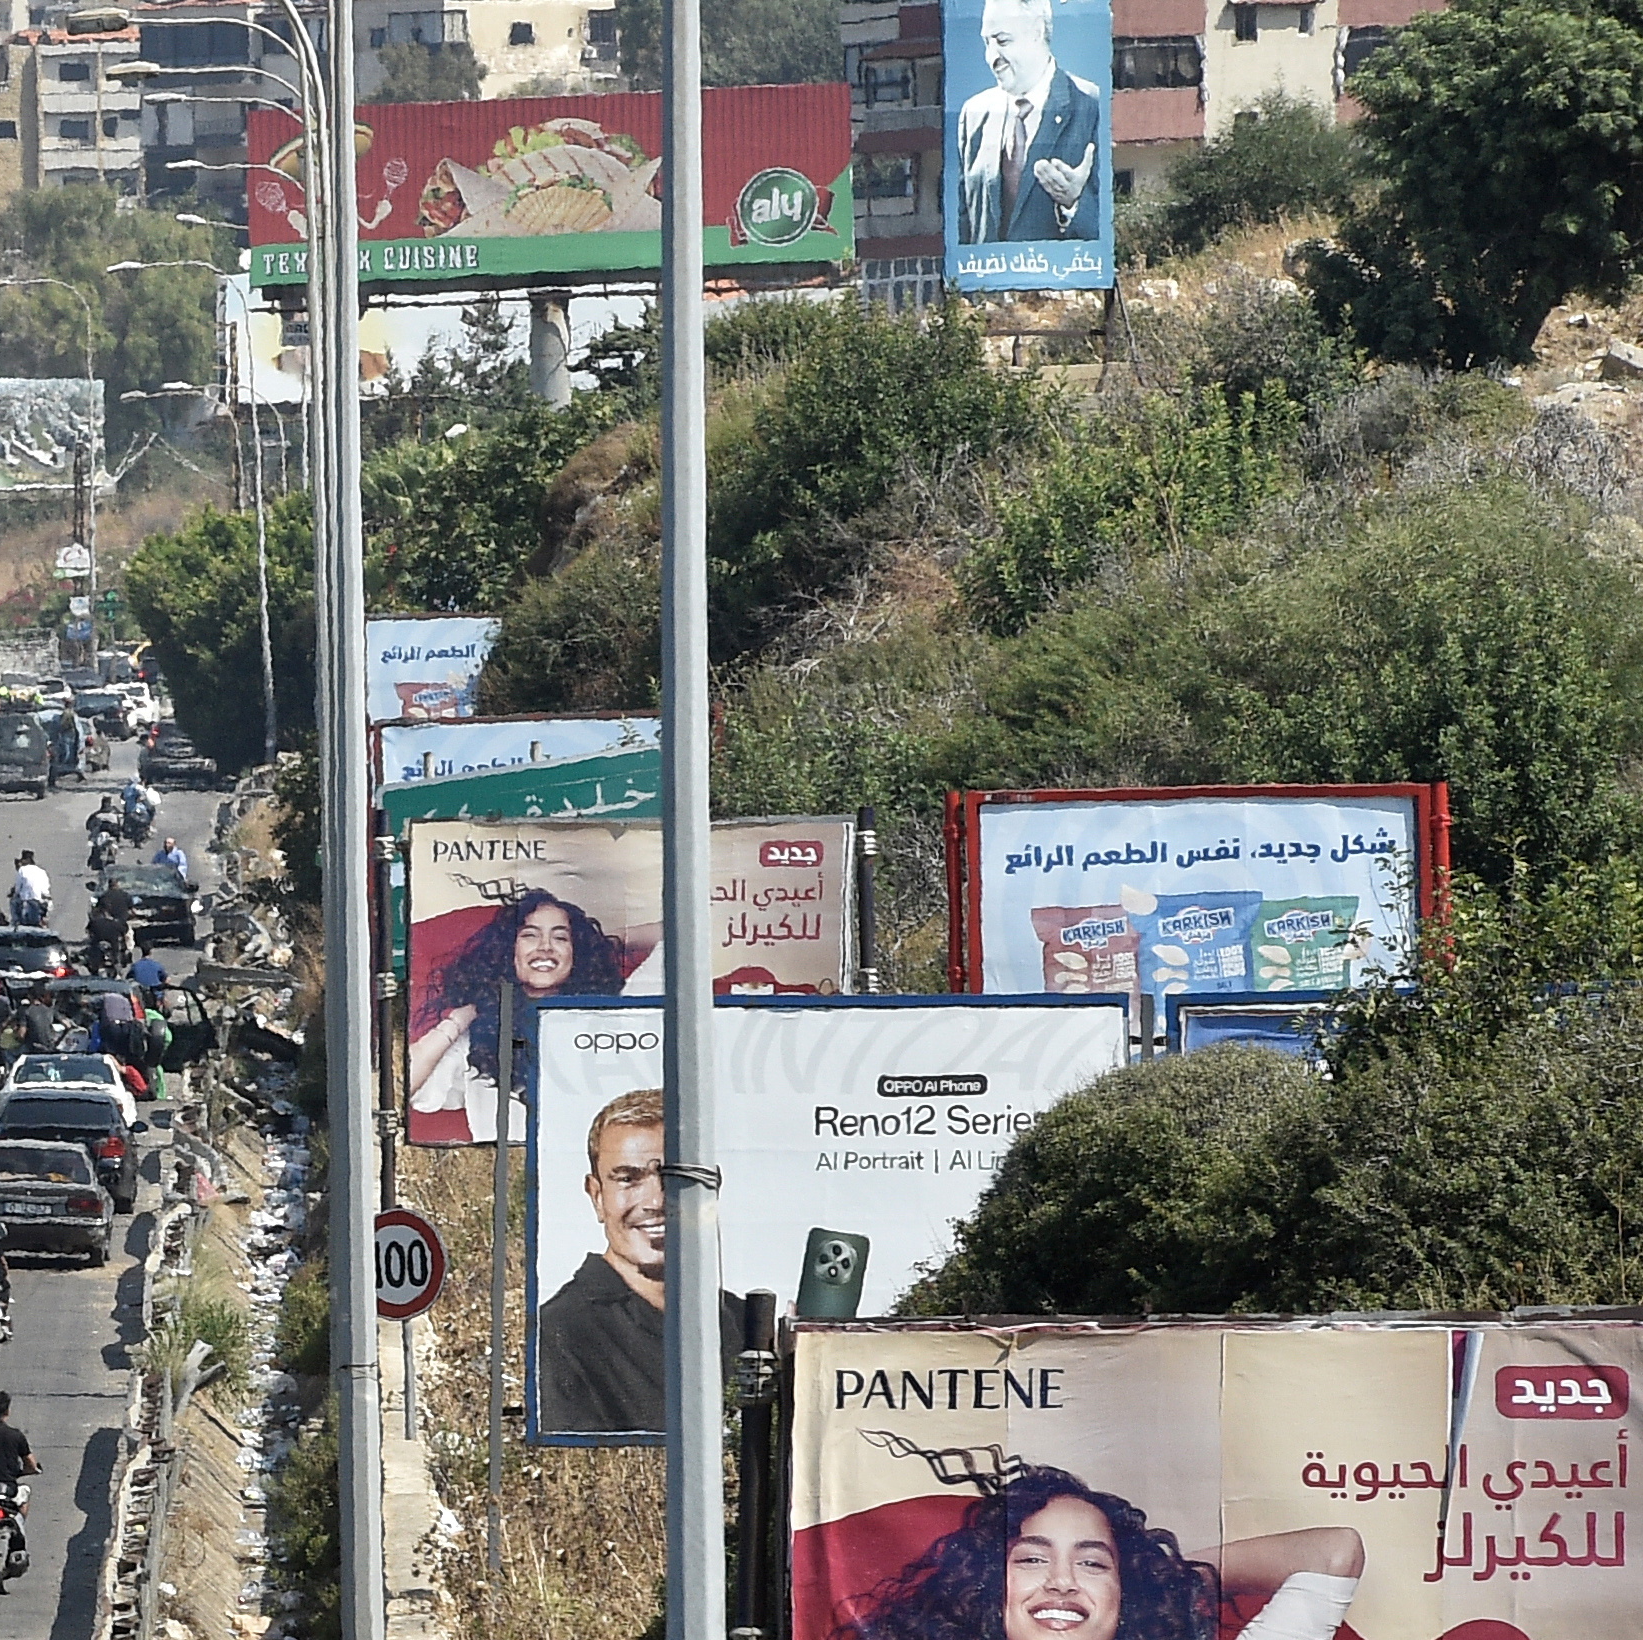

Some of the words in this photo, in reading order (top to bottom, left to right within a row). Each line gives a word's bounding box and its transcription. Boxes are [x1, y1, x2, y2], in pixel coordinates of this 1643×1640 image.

[751, 193, 803, 224] aly
[383, 244, 479, 271] CUISINE
[433, 840, 548, 862] PANTENE
[767, 846, 817, 865] جديد
[1004, 844, 1074, 875] الرائع
[1081, 841, 1168, 872] الطعم
[1176, 837, 1241, 869] نفس
[1330, 827, 1397, 863] شكل
[753, 871, 824, 911] أعيدي
[722, 912, 822, 948] للكيرلز
[1062, 919, 1126, 942] KARKISH
[1161, 912, 1234, 934] KARKISH
[1266, 913, 1332, 937] KARKISH
[574, 1031, 659, 1054] oppo
[883, 1079, 922, 1093] OPPO
[940, 1078, 982, 1093] Phone
[815, 1104, 937, 1137] Reno12
[947, 1105, 1040, 1136] Serie
[844, 1150, 925, 1171] Portrait
[375, 1238, 429, 1289] 100
[835, 1367, 1065, 1411] PANTENE
[1511, 1377, 1612, 1414] جديد
[1301, 1443, 1468, 1502] الحيوية
[1481, 1428, 1629, 1511] أعيدي
[1423, 1510, 1626, 1583] للكيرلز
